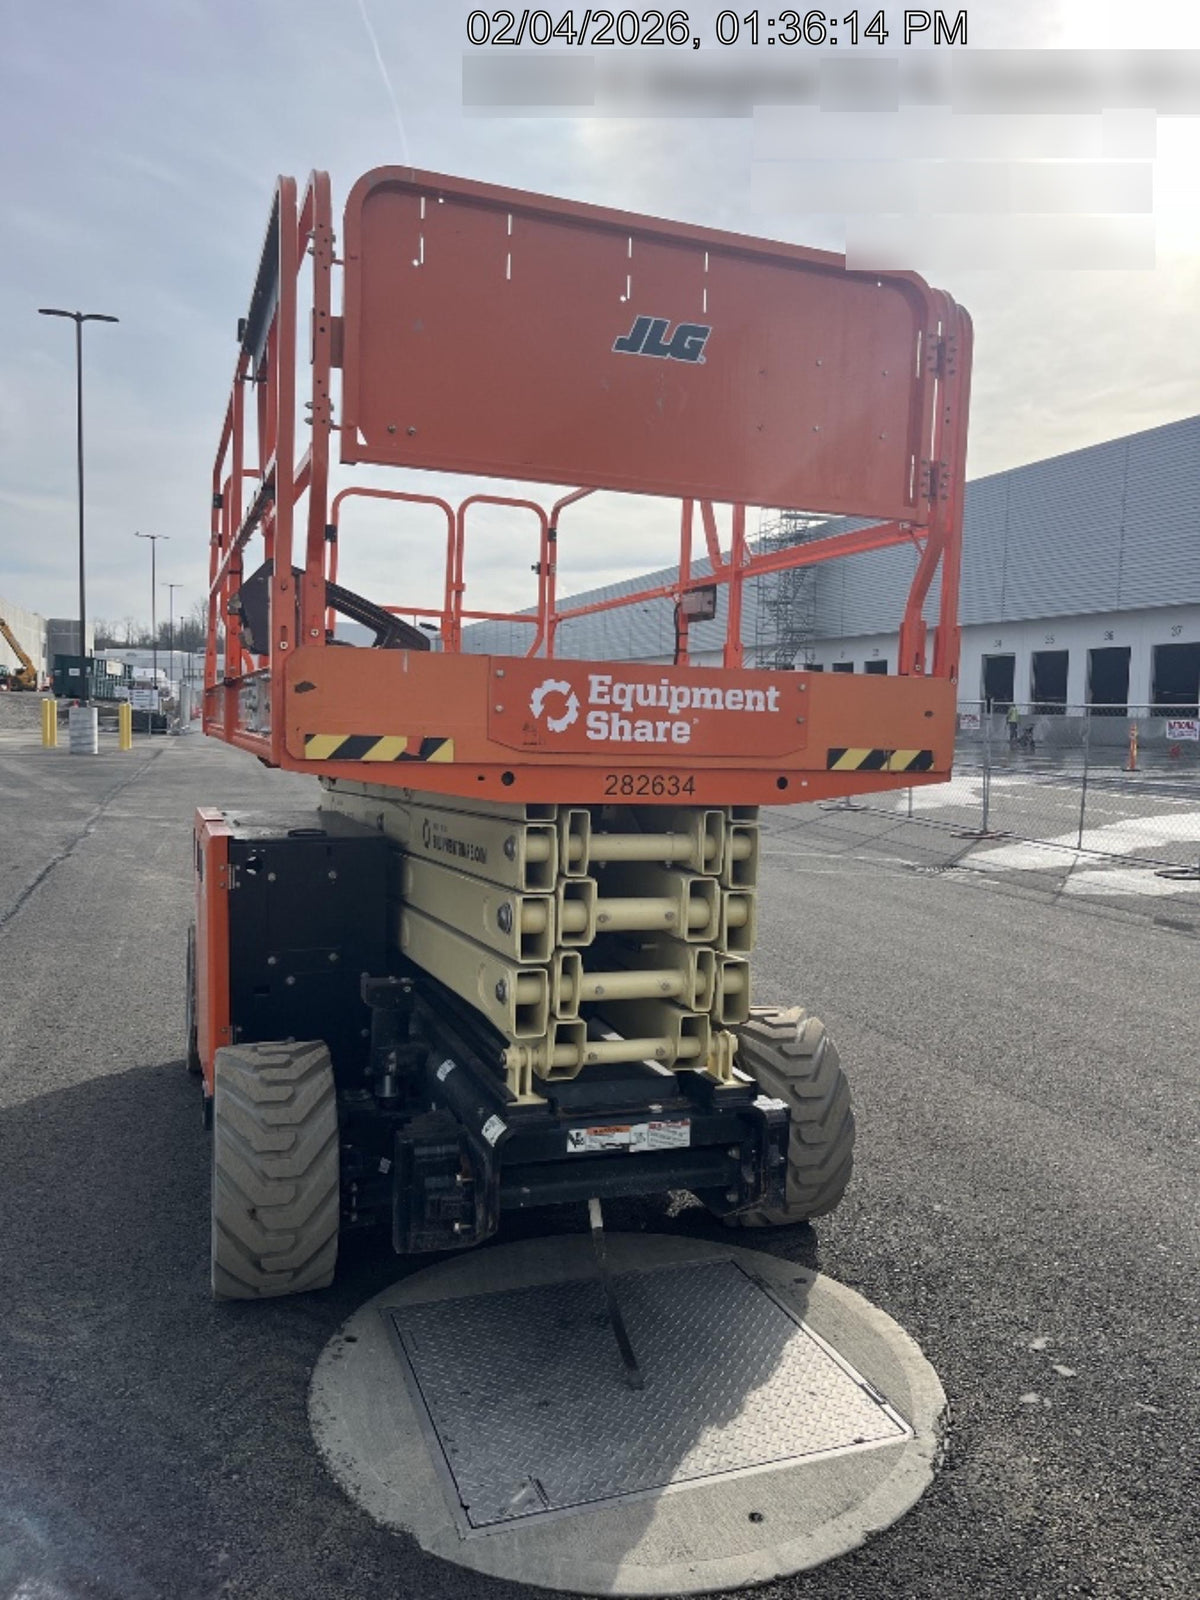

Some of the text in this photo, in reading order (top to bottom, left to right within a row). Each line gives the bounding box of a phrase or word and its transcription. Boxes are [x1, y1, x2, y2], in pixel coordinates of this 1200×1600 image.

[612, 315, 712, 363] JLG
[588, 674, 780, 715] Equipment
[586, 710, 691, 744] Share
[604, 774, 696, 797] 282634
